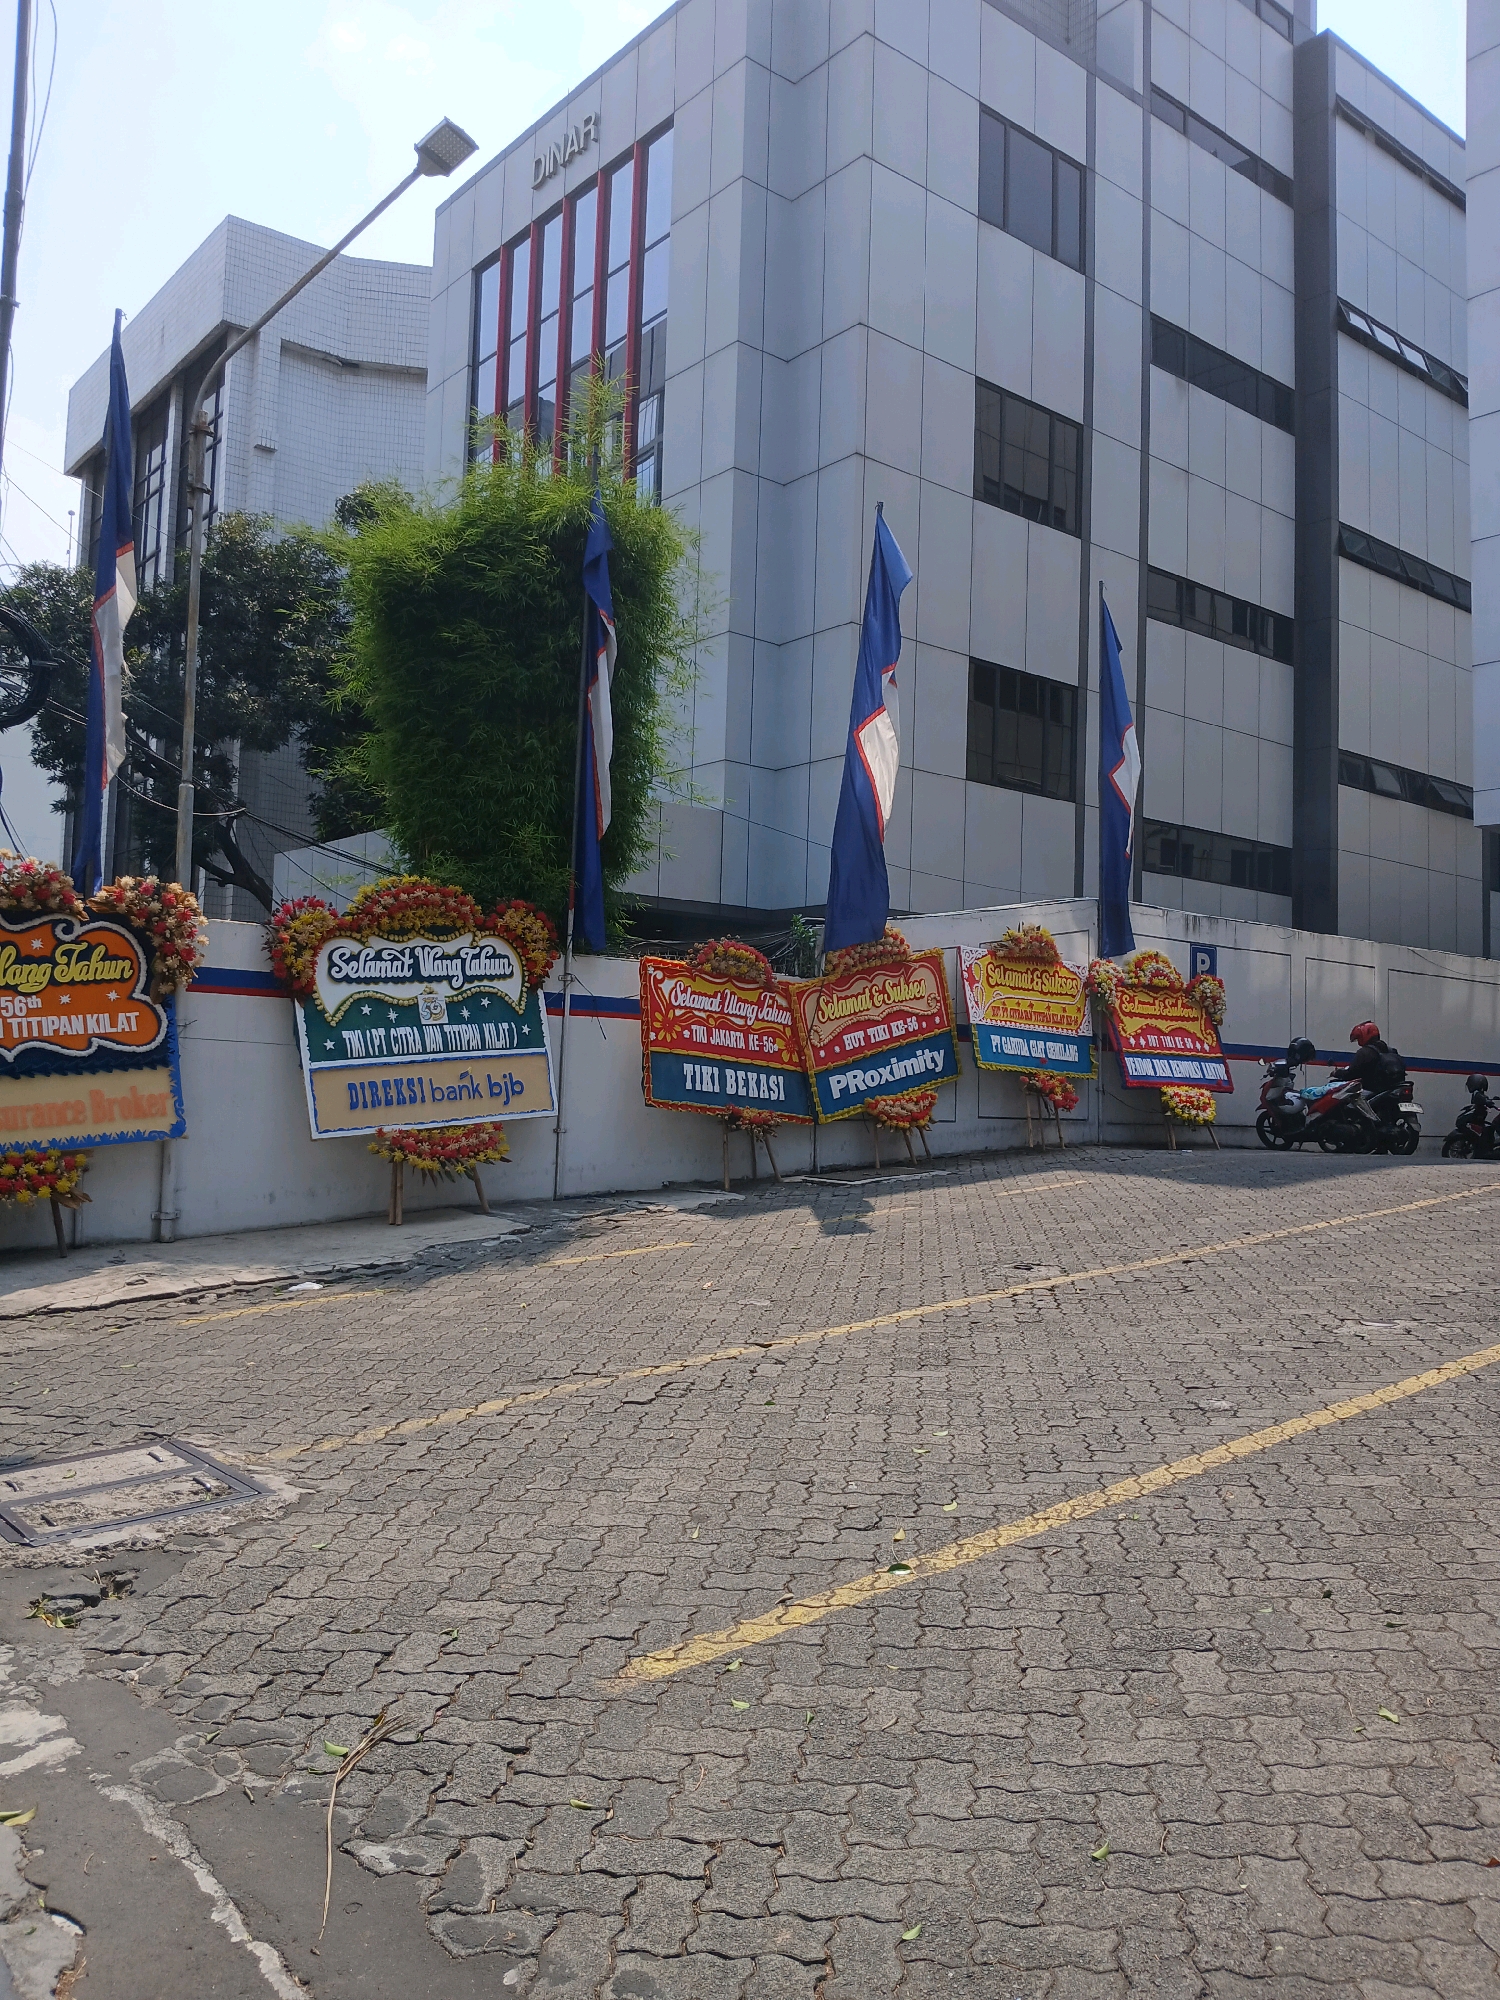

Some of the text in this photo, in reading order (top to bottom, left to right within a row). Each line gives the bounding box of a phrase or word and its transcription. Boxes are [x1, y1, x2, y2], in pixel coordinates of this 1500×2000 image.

[531, 111, 599, 190] DINAR
[0, 942, 133, 993] lang Tahun
[331, 946, 513, 989] Selamat Ulang Tahun
[987, 963, 1078, 996] Selamat & Sukses
[1197, 952, 1211, 976] P
[0, 994, 42, 1018] 56th
[671, 980, 792, 1026] Selamat Ulang Tahun
[818, 974, 926, 1023] Selamat & Sukses
[7, 1013, 85, 1039] TITIPAN
[86, 1012, 139, 1034] KILAT
[342, 1030, 365, 1058] TIKI
[390, 1026, 422, 1055] CITRA
[422, 1025, 443, 1052] VAN
[444, 1023, 482, 1051] TITIPAN
[691, 1025, 774, 1054] TIKI JAKARTA KE-56
[843, 1016, 919, 1050] HUT TIKI KE-56
[990, 1035, 1001, 1053] PT
[1001, 1036, 1030, 1057] GARUDA
[347, 1072, 525, 1110] DIREKSI bank bjb
[683, 1063, 785, 1101] TIKI BEKASI
[829, 1048, 945, 1099] PRoximity
[90, 1086, 171, 1124] Broker
